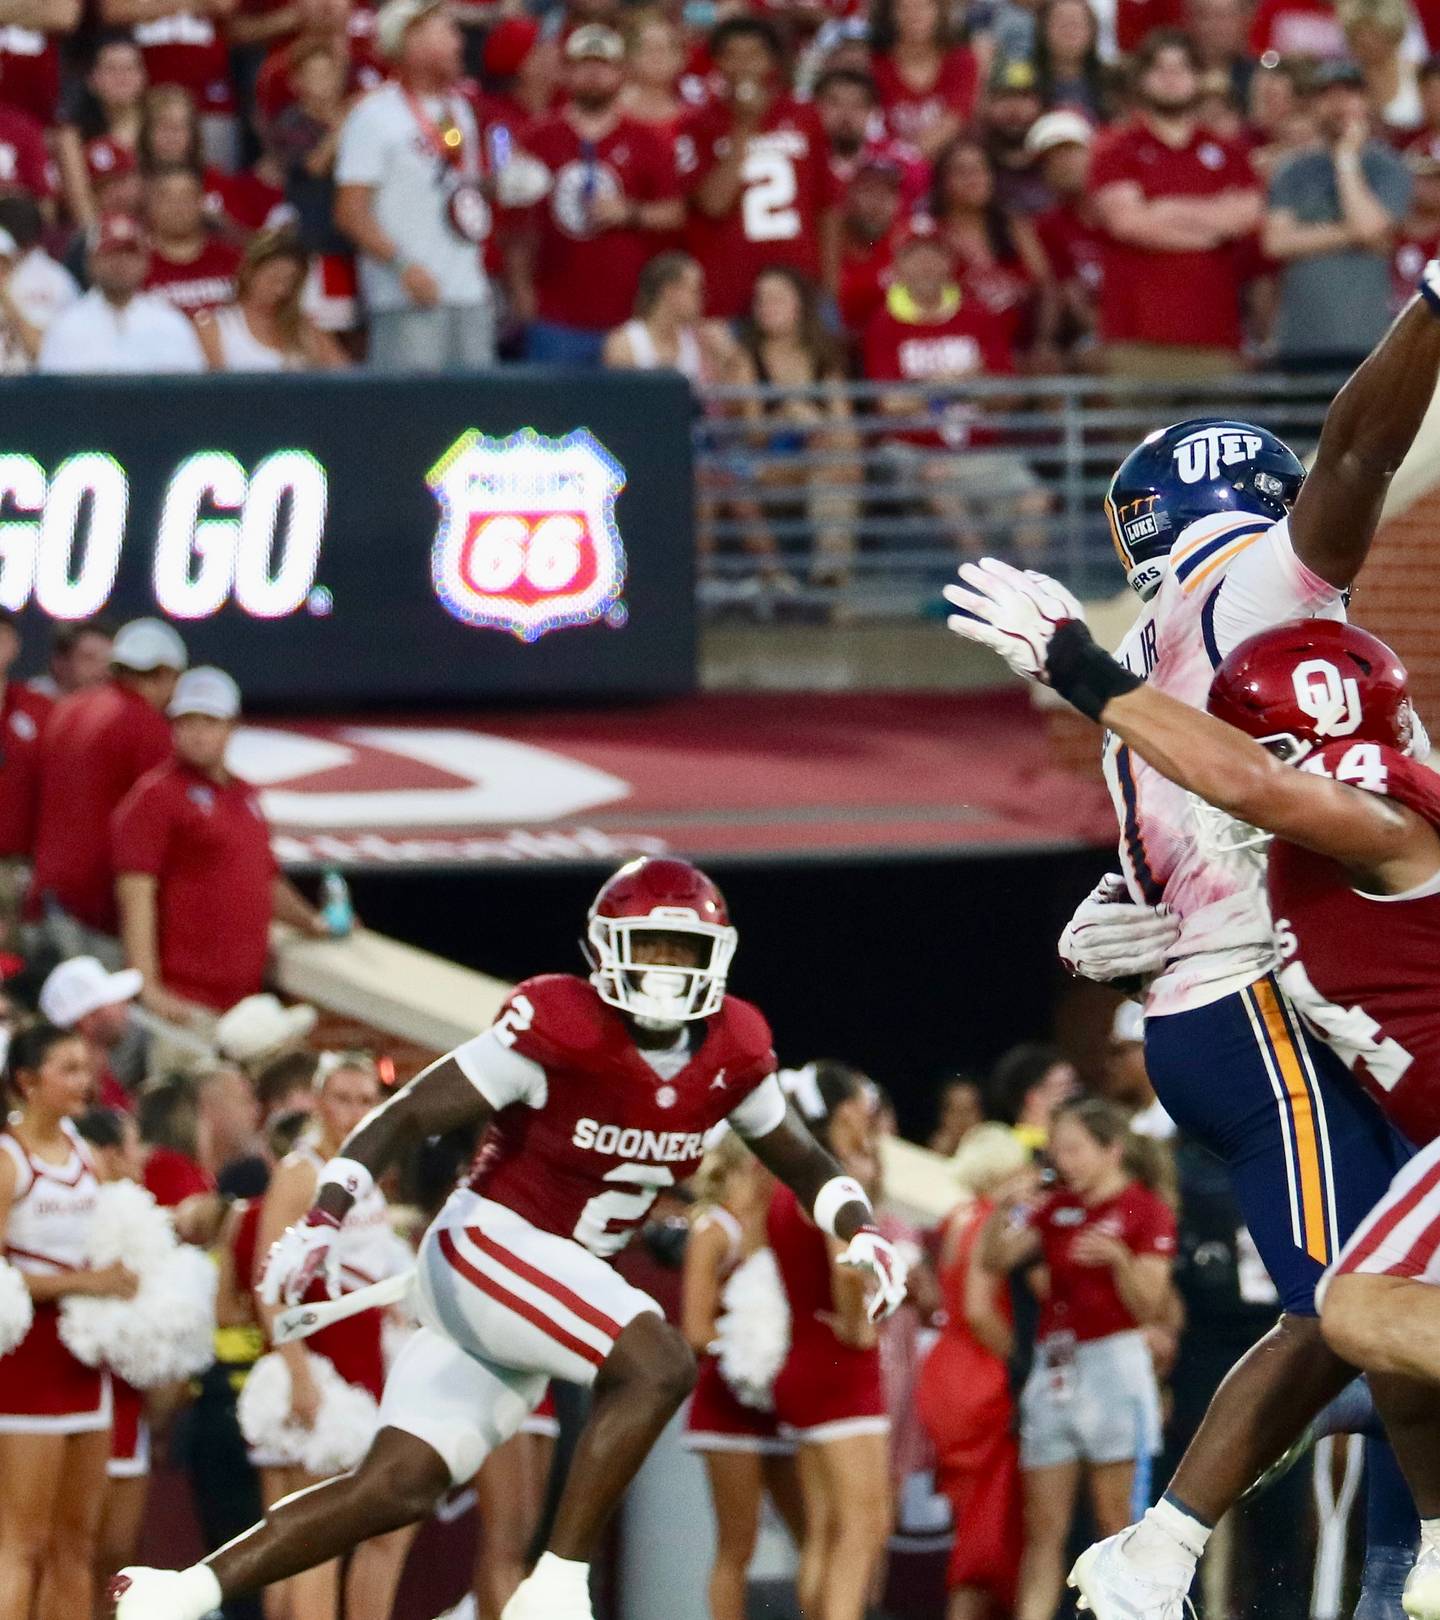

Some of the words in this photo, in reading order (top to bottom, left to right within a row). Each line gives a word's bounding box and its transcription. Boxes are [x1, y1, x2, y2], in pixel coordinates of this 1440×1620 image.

[742, 156, 801, 242] 2
[1173, 427, 1263, 484] UTEP
[154, 449, 329, 619] GO
[469, 515, 585, 592] 66
[1127, 517, 1155, 541] LUKE
[1292, 658, 1363, 737] OU
[494, 994, 535, 1048] 2
[572, 1162, 675, 1258] 2
